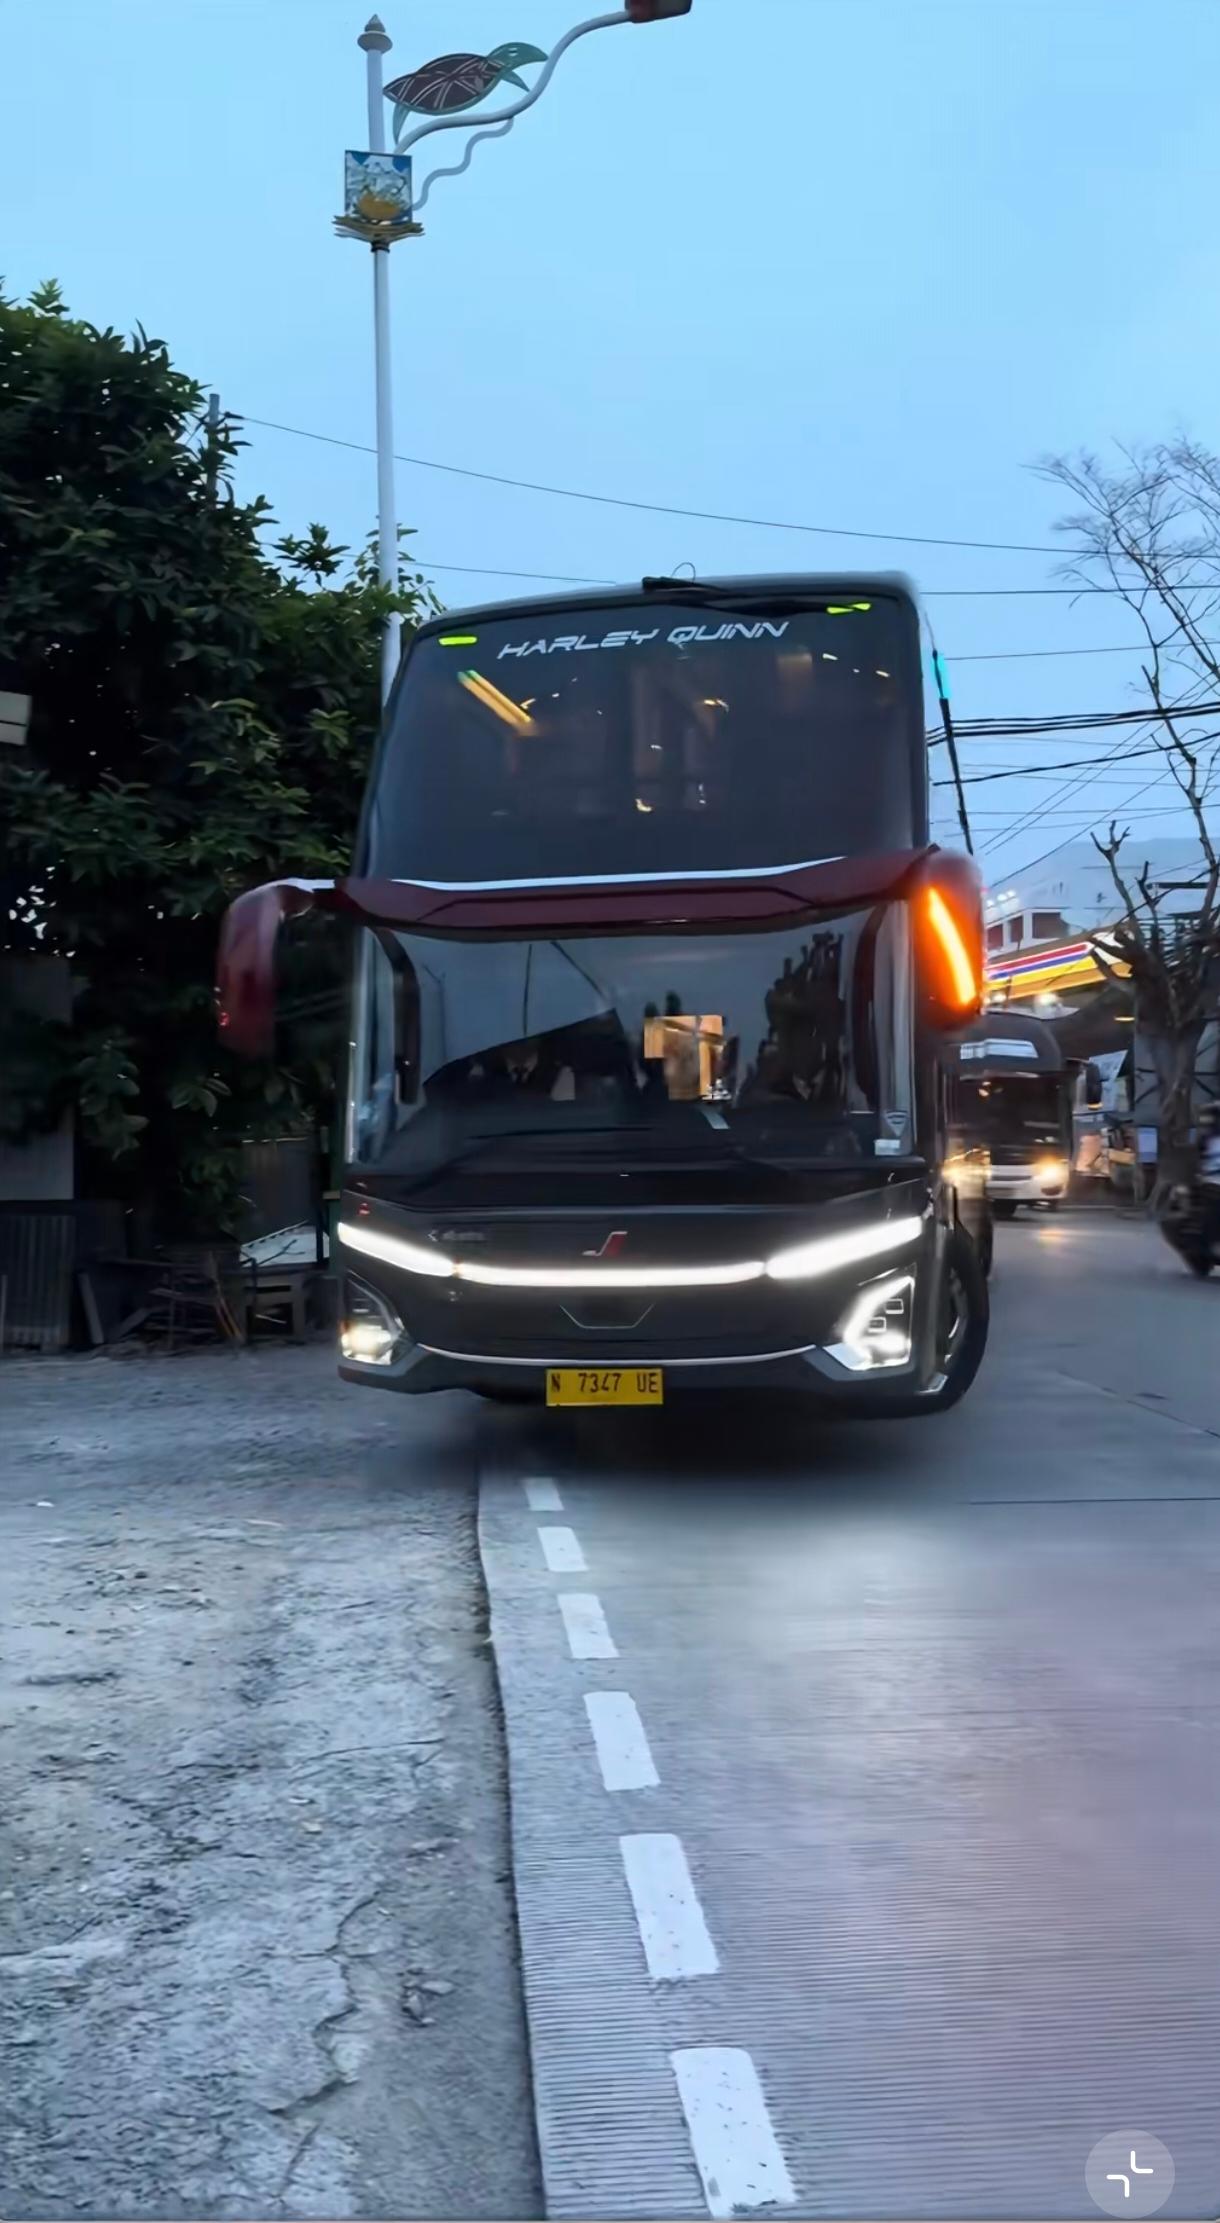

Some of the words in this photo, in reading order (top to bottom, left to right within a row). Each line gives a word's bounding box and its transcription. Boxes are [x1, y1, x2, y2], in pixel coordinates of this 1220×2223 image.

[497, 628, 660, 659] HARLEY
[667, 621, 790, 645] QUINN
[551, 1373, 561, 1392] N
[578, 1372, 622, 1393] 7347
[636, 1372, 659, 1393] UE
